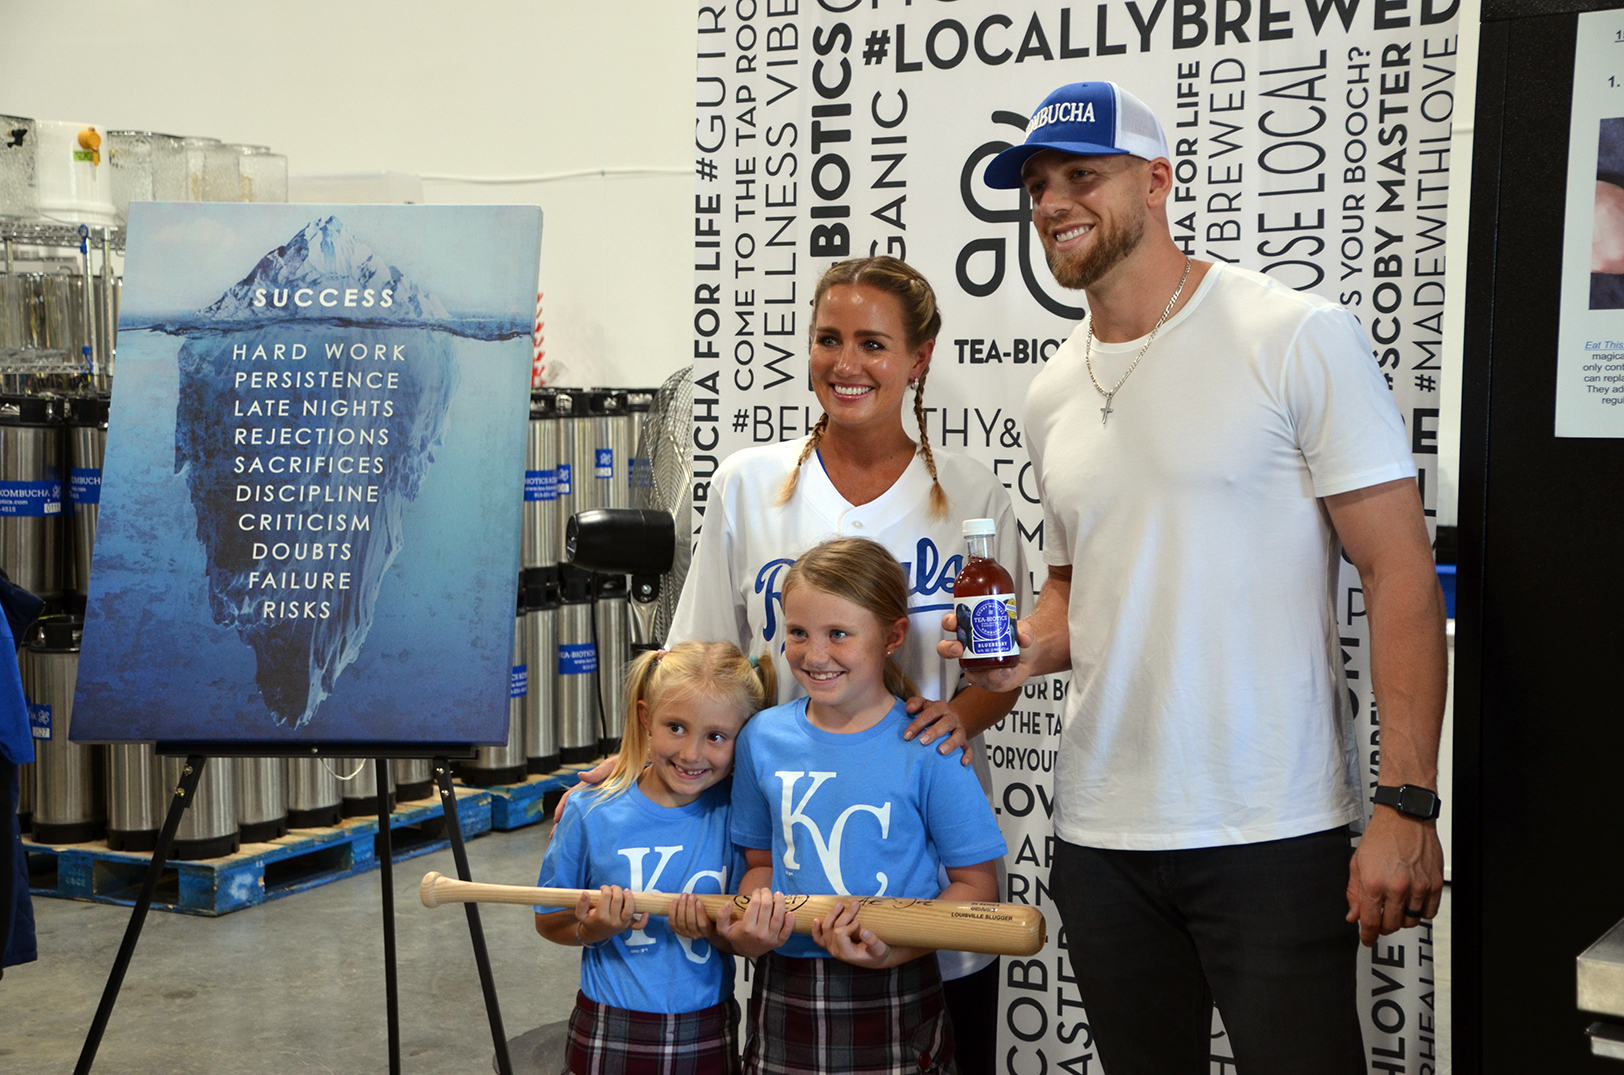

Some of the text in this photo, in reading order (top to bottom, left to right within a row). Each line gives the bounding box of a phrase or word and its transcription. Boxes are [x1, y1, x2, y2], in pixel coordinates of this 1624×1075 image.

[863, 0, 1460, 73] #LOCALLYBREWED
[1176, 60, 1201, 128] LIFE
[1608, 76, 1621, 88] 1.
[736, 85, 757, 147] TAP
[1023, 101, 1096, 144] MBUCHA
[1258, 49, 1328, 197] LOCAL
[1344, 46, 1371, 183] BOOCH?
[1375, 42, 1412, 212] MASTER
[735, 157, 757, 223] THE
[1175, 137, 1199, 202] FOR
[763, 0, 799, 390] WELLNESS VIBE
[810, 22, 853, 391] BIOTICS
[1411, 34, 1459, 393] #MADEWITHLOVE
[695, 193, 722, 272] LIFE
[1341, 193, 1366, 281] YOUR
[735, 232, 756, 279] TO
[253, 288, 394, 308] SUCCESS
[693, 283, 721, 359] FOR
[734, 288, 756, 391] COME
[233, 343, 406, 361] HARD WORK
[953, 338, 1068, 364] TEA-BIO
[1584, 341, 1601, 350] Eat
[235, 371, 399, 389] PERSISTENCE
[1583, 364, 1602, 373] only
[1587, 385, 1610, 395] They
[234, 399, 394, 417] LATE NIGHTS
[234, 427, 389, 445] REJECTIONS
[233, 456, 384, 474] SACRIFICES
[693, 371, 721, 556] BUCHA
[236, 485, 379, 502] DISCIPLINE
[238, 513, 370, 531] CRITICISM
[252, 542, 352, 560] DOUBTS
[248, 572, 351, 589] FAILURE
[263, 601, 331, 619] RISKS
[1010, 710, 1041, 735] THE
[995, 782, 1054, 820] OV
[774, 770, 892, 897] KC
[617, 845, 728, 964] KC
[951, 911, 985, 920] LOUISVILLE
[1007, 936, 1048, 1075] COB
